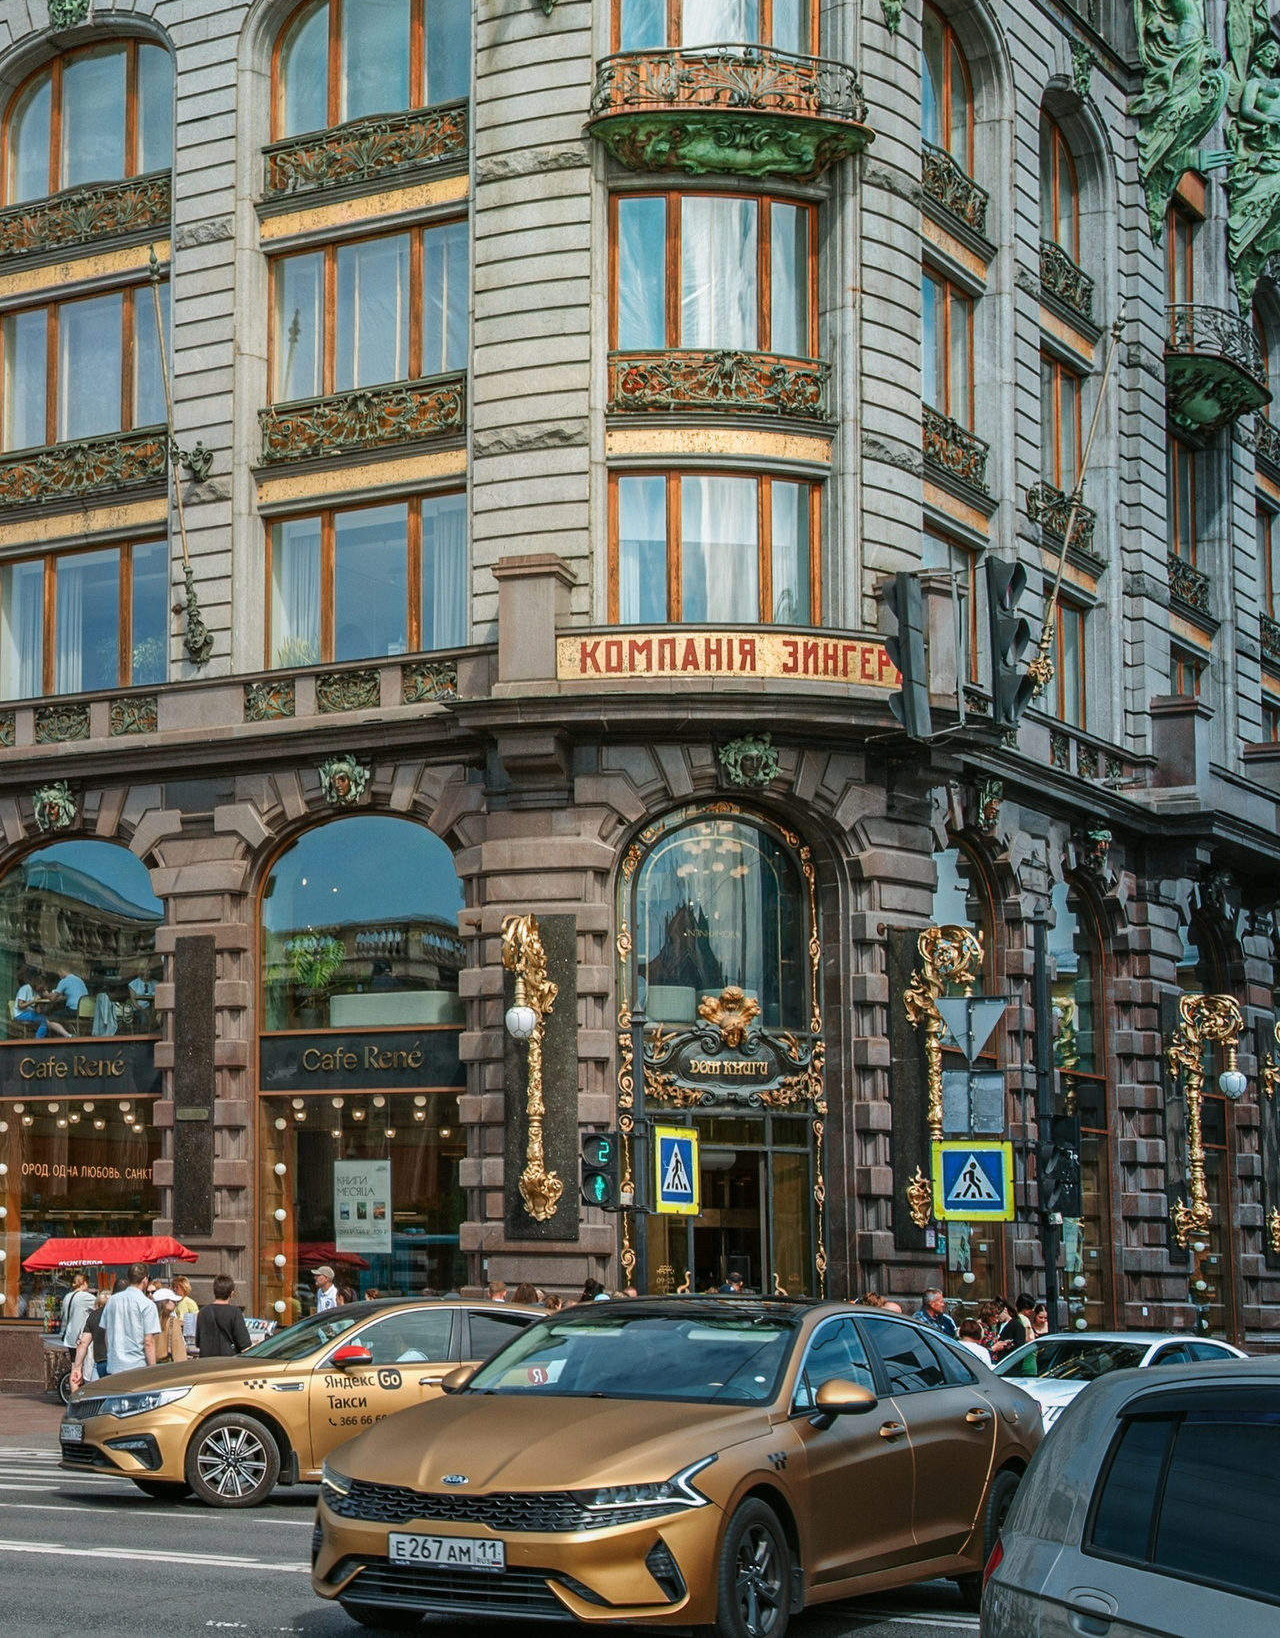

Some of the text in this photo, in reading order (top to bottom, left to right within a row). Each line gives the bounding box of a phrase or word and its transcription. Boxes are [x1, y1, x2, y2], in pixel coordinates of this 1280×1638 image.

[579, 638, 758, 674] КОМПАНІЯ
[19, 1050, 127, 1080] Cafe René
[302, 1040, 425, 1072] Cafe René
[598, 1141, 610, 1162] 2
[52, 1164, 79, 1179] ОДНА
[124, 1167, 153, 1181] САНКТ
[336, 1186, 376, 1198] МЕСЯЦА
[324, 1370, 400, 1389] Яндекс Go
[326, 1394, 368, 1410] Такси
[339, 1415, 358, 1427] 366
[360, 1414, 373, 1426] 66
[478, 1541, 497, 1559] 11
